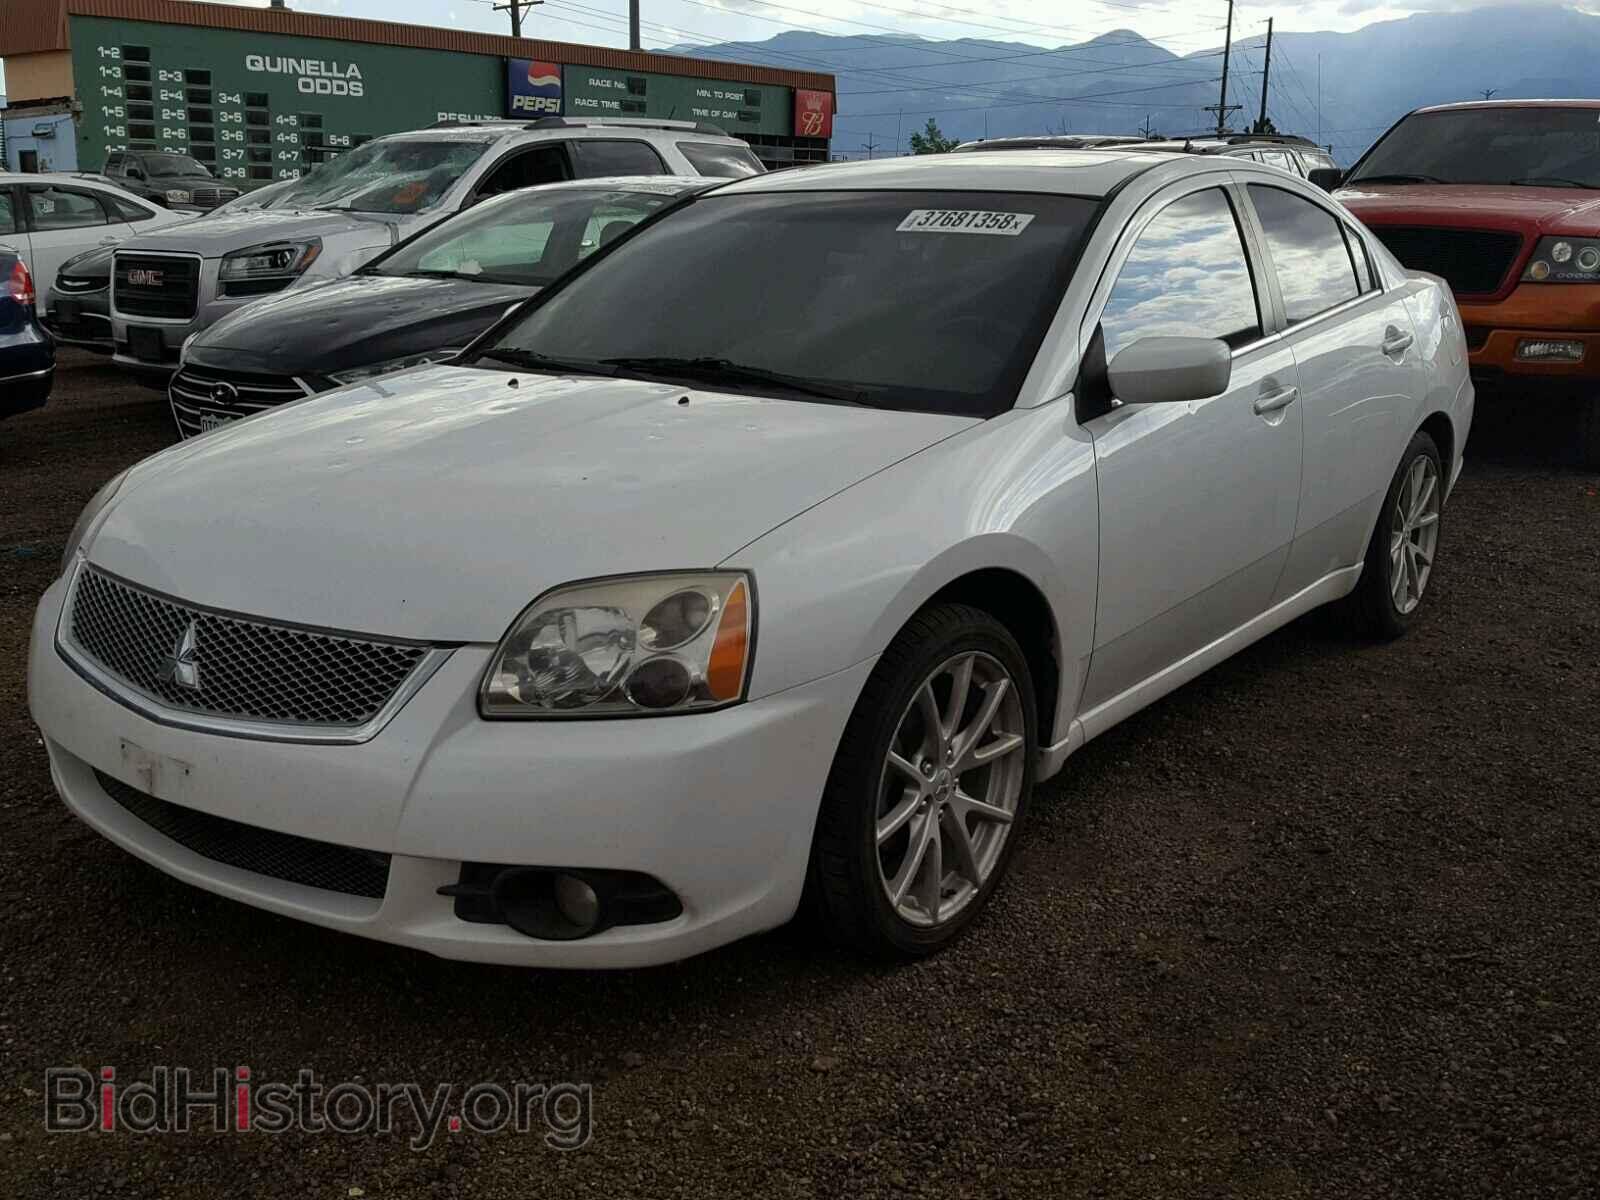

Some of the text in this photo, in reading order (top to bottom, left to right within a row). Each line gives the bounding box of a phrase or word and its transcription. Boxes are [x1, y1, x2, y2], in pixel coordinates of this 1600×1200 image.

[97, 46, 121, 59] 1-2
[99, 66, 122, 78] 1-3
[245, 54, 362, 79] QUINELLA
[158, 70, 183, 82] 2-3
[297, 77, 364, 97] ODDS
[588, 78, 612, 88] RACE
[100, 85, 123, 98] 1-4
[160, 89, 184, 101] 2-4
[714, 90, 724, 98] TO
[725, 92, 745, 101] POST
[218, 92, 241, 104] 3-4
[512, 94, 561, 113] PEPSI
[574, 98, 621, 110] RACE TIME
[102, 105, 125, 118] 1-5
[161, 108, 186, 121] 2-5
[219, 111, 243, 123] 3-5
[692, 108, 709, 117] TIME
[275, 114, 298, 126] 4-5
[103, 125, 126, 137] 1-6
[162, 127, 187, 140] 2-6
[221, 130, 244, 142] 3-6
[276, 133, 299, 144] 4-6
[222, 148, 245, 160] 3-7
[278, 151, 300, 162] 4-7
[127, 268, 164, 287] GMC
